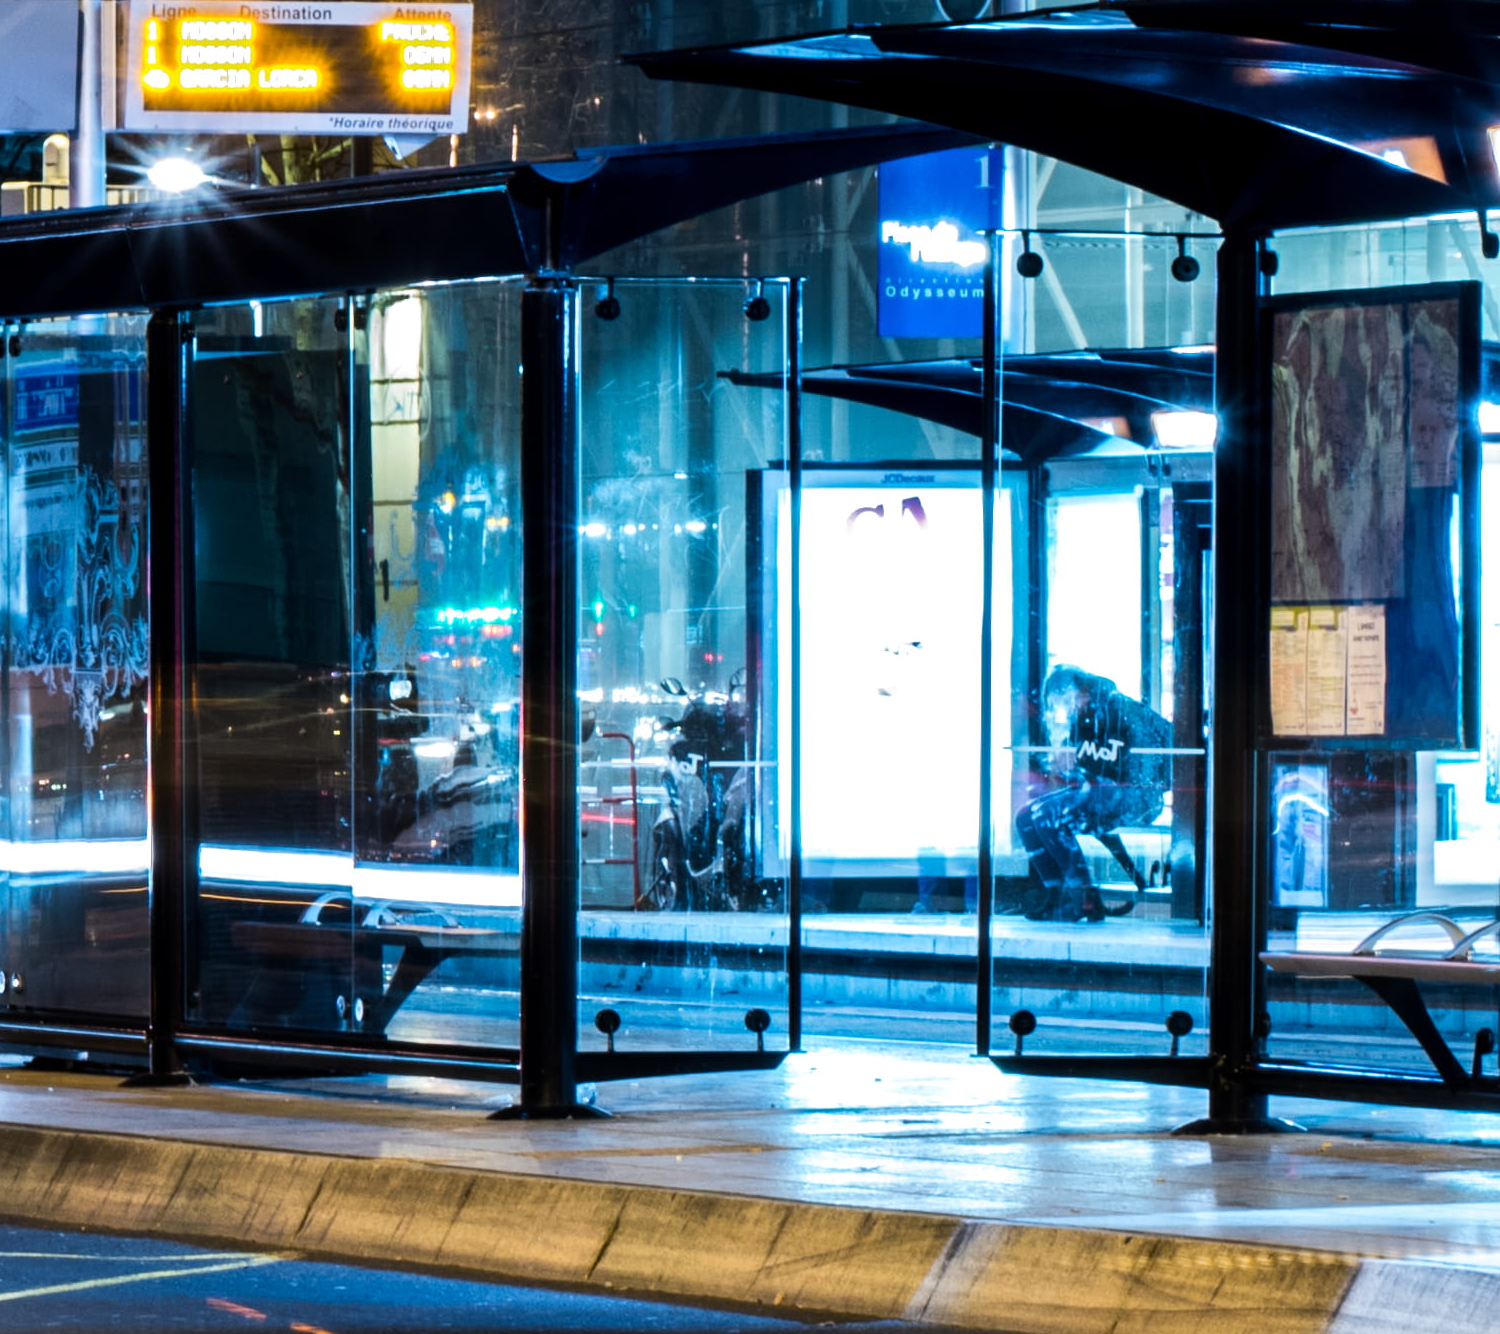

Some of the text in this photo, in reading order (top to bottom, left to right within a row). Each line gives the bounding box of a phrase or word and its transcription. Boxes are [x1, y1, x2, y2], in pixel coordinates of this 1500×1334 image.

[239, 5, 332, 20] Destination
[388, 118, 453, 131] théorique
[975, 156, 993, 188] 1
[885, 286, 984, 299] Odysseum
